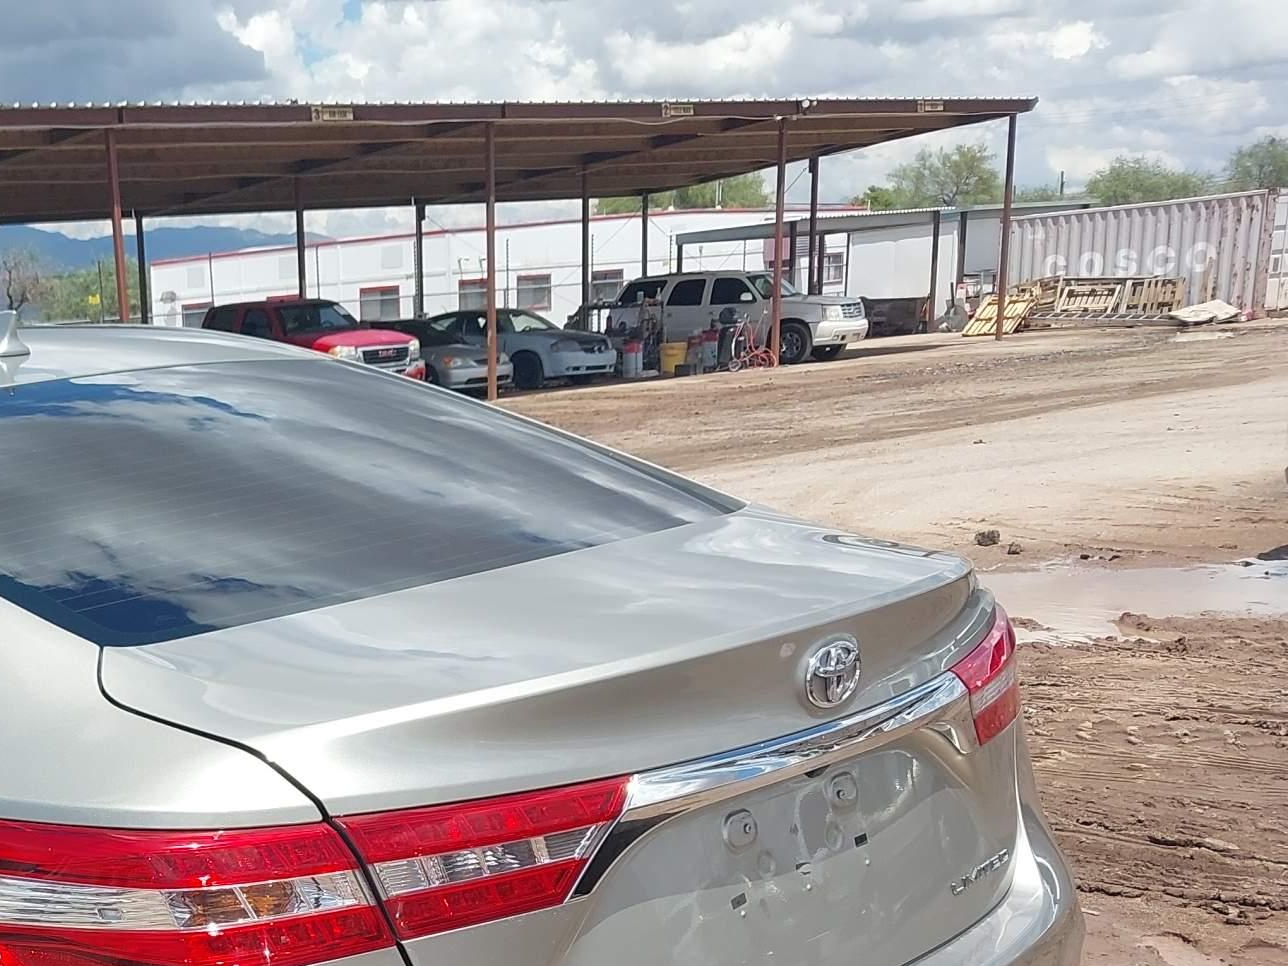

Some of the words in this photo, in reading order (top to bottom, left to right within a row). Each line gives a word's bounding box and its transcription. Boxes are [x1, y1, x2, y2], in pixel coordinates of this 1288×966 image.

[313, 108, 321, 121] 3
[1044, 241, 1217, 277] COSCO
[951, 848, 1009, 896] LIMITED
